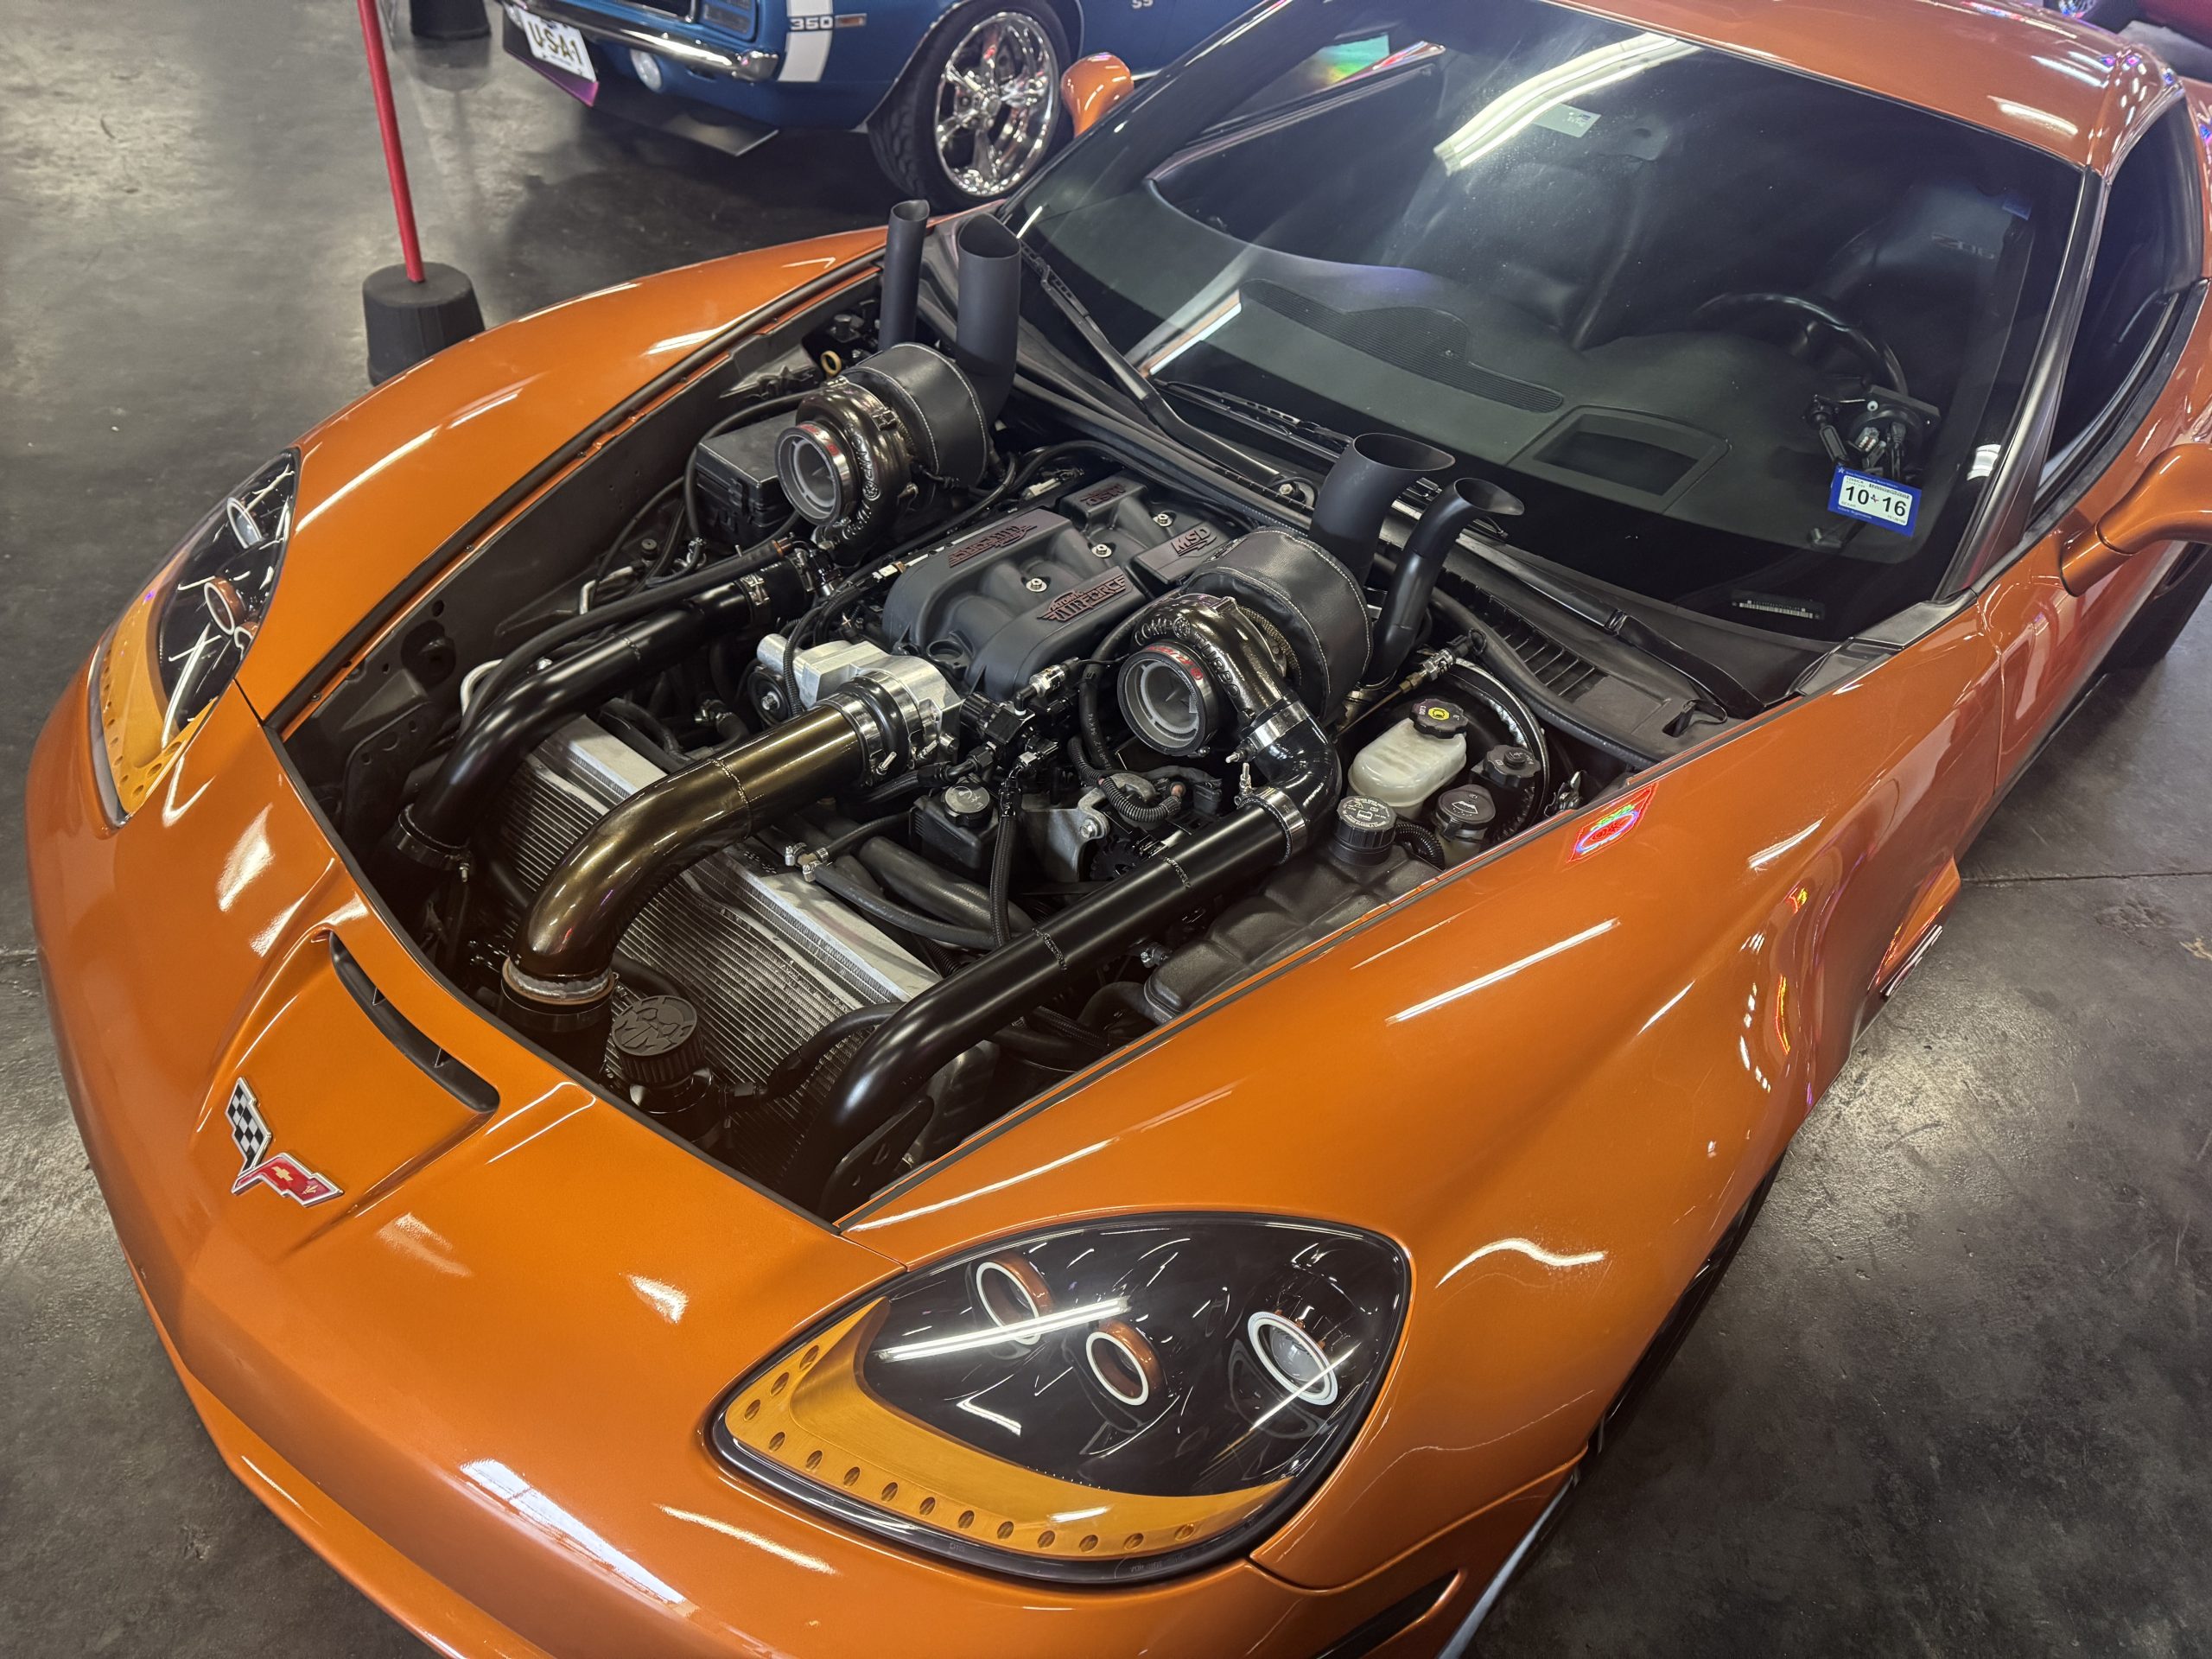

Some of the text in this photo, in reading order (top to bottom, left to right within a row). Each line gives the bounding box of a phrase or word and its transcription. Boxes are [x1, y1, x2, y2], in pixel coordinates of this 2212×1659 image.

[790, 16, 834, 31] 350
[1845, 486, 1870, 505] 10
[1882, 496, 1907, 517] 16
[1170, 525, 1215, 556] MSD
[1135, 618, 1173, 646] COMP
[1193, 631, 1241, 698] TURBO
